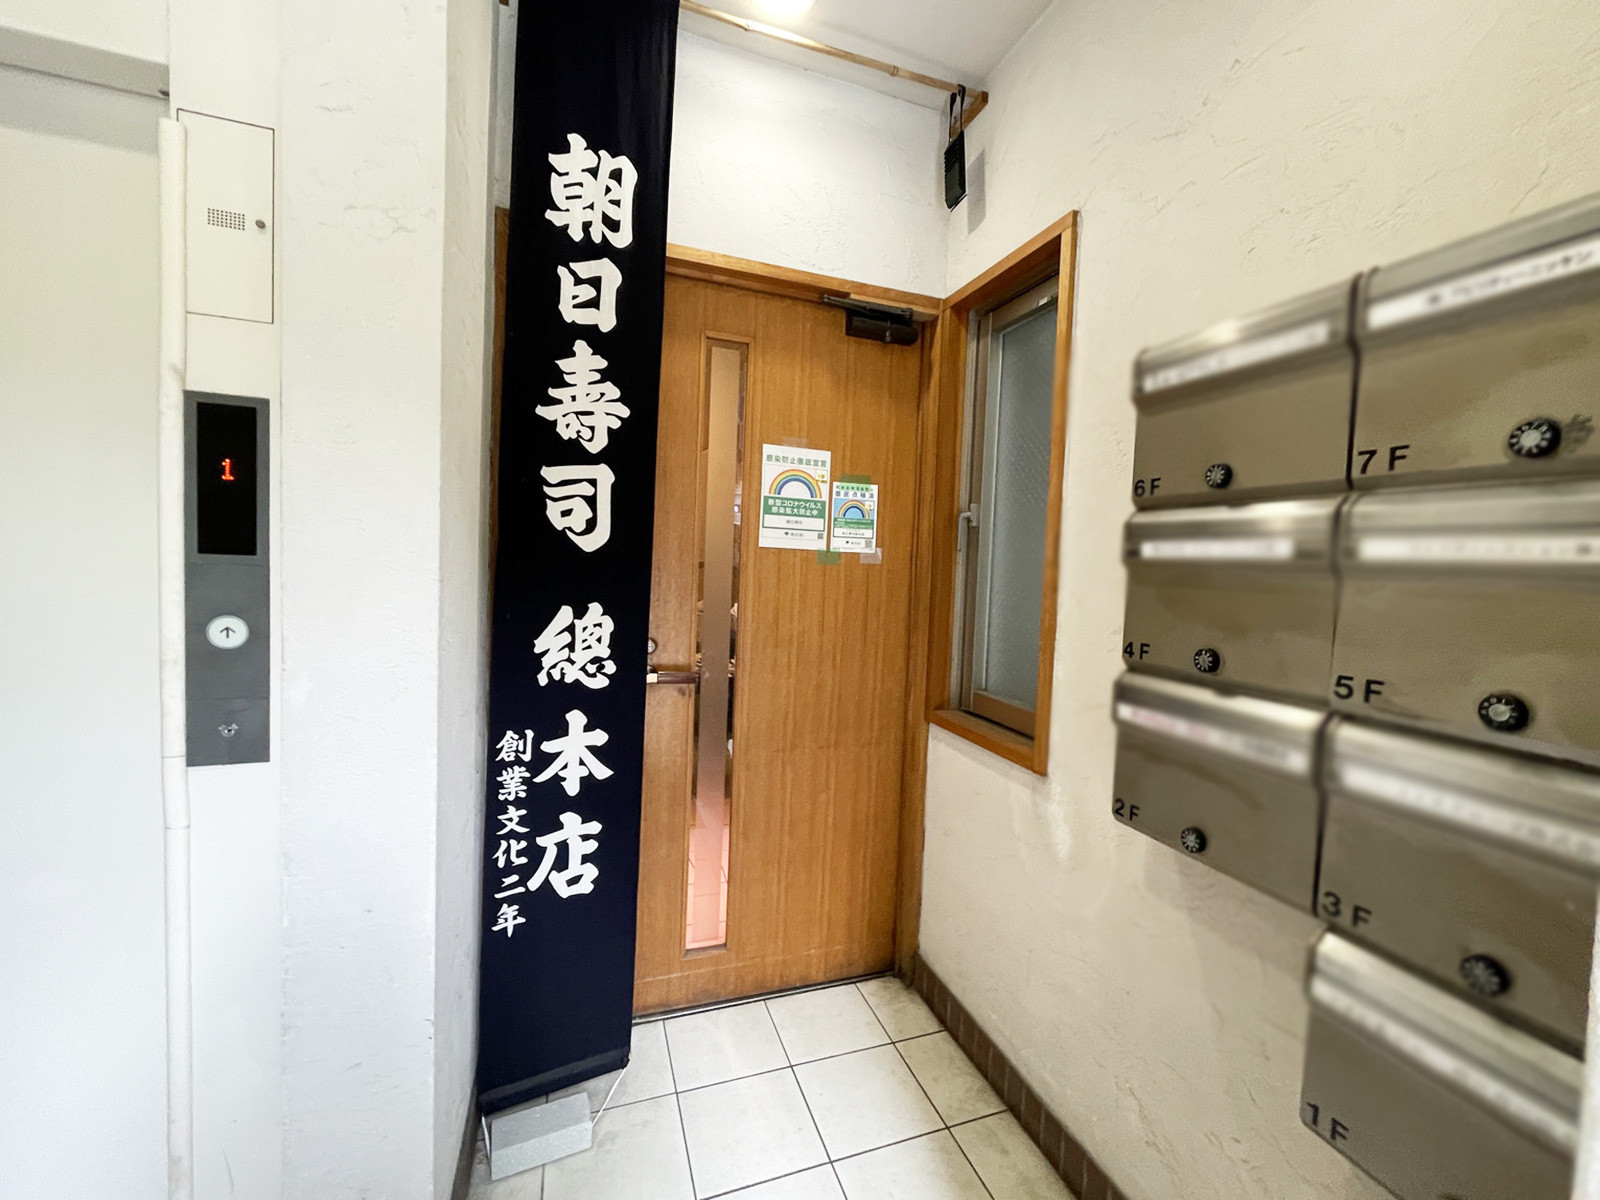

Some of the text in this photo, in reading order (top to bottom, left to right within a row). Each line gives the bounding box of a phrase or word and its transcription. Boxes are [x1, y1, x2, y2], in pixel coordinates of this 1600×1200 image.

[221, 458, 235, 482] 1
[1357, 445, 1411, 476] 7F
[1133, 477, 1162, 498] 6F
[527, 132, 637, 899] 朝日壽司 總本店
[1122, 641, 1151, 660] 4F
[1333, 674, 1386, 704] 5F
[1112, 796, 1141, 822] 2F
[491, 729, 535, 938] 創業文化二年
[1321, 891, 1373, 929] 3F
[1306, 1102, 1350, 1142] 1F
